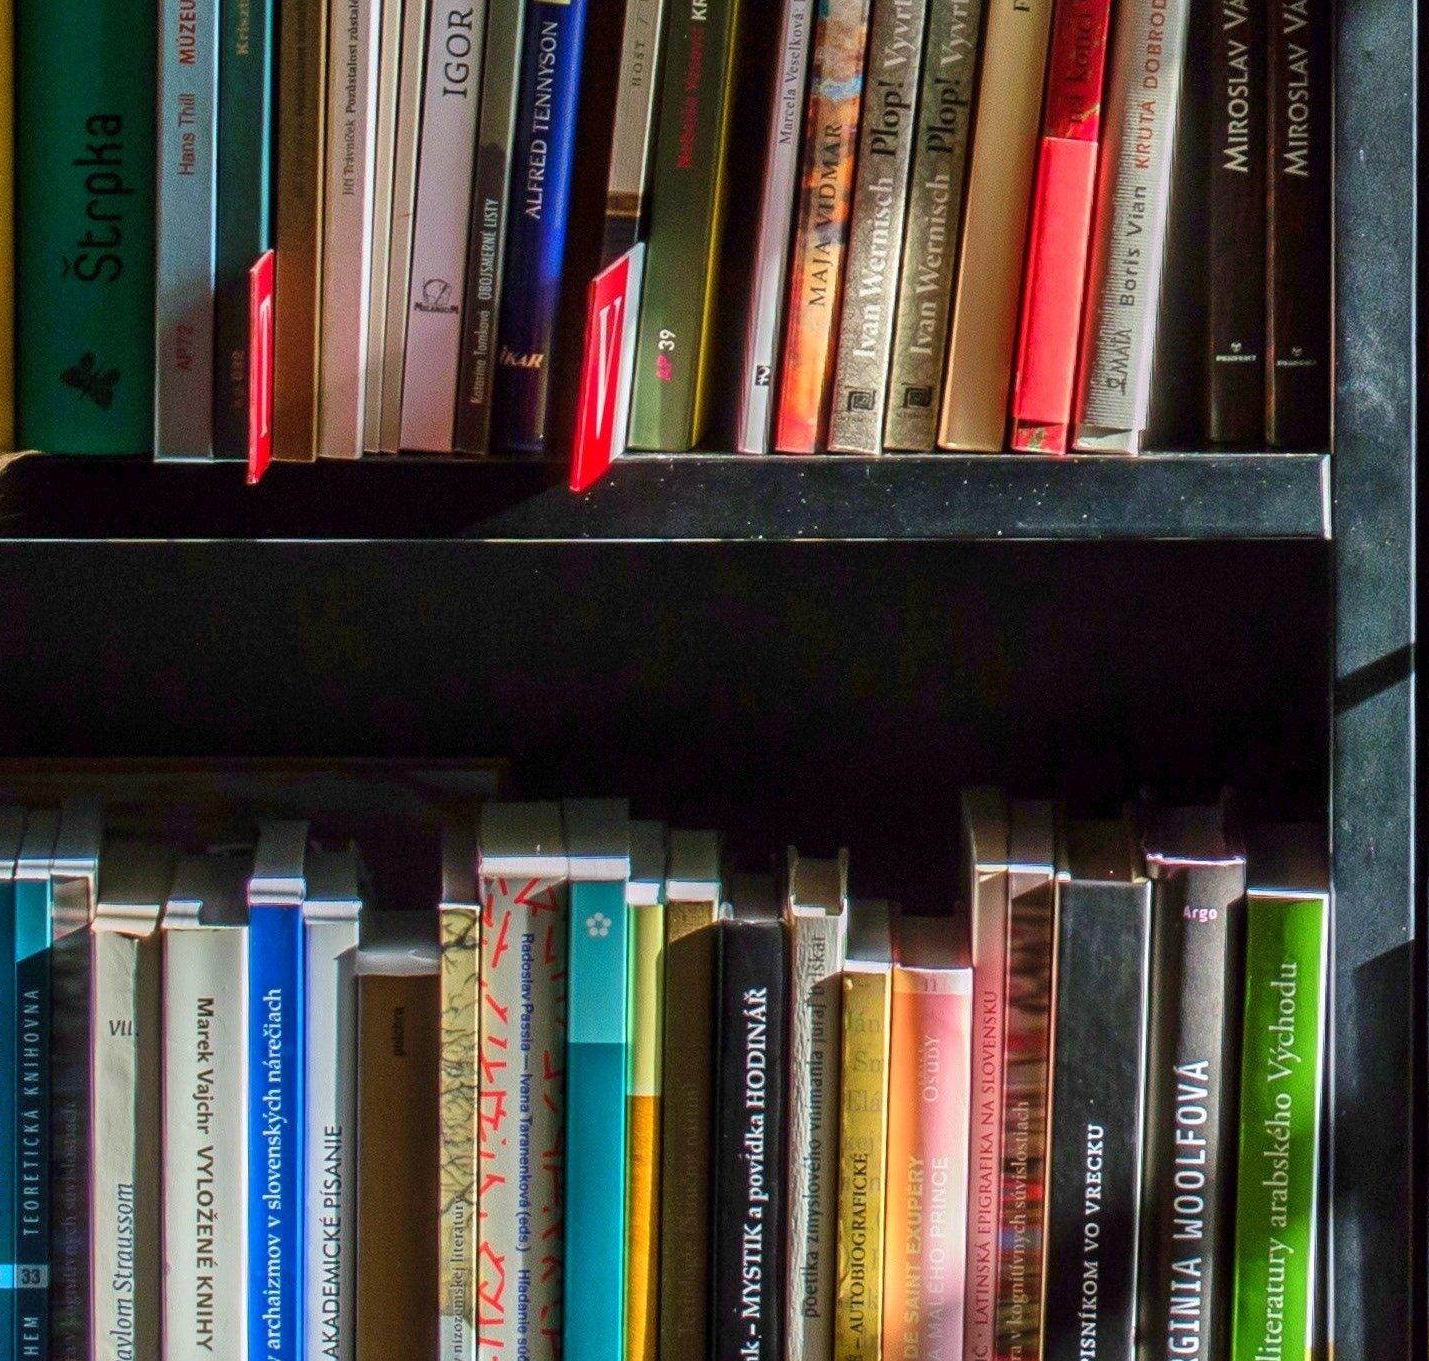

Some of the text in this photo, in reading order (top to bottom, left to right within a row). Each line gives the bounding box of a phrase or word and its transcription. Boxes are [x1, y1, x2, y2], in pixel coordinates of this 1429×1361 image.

[442, 7, 473, 99] IGOR
[524, 21, 558, 220] ALFRED TENNYSON
[1222, 40, 1249, 173] MIROSLAV
[61, 113, 134, 283] Štrpka
[808, 124, 842, 308] MAJA VIDMAR
[1183, 905, 1217, 922] Argo
